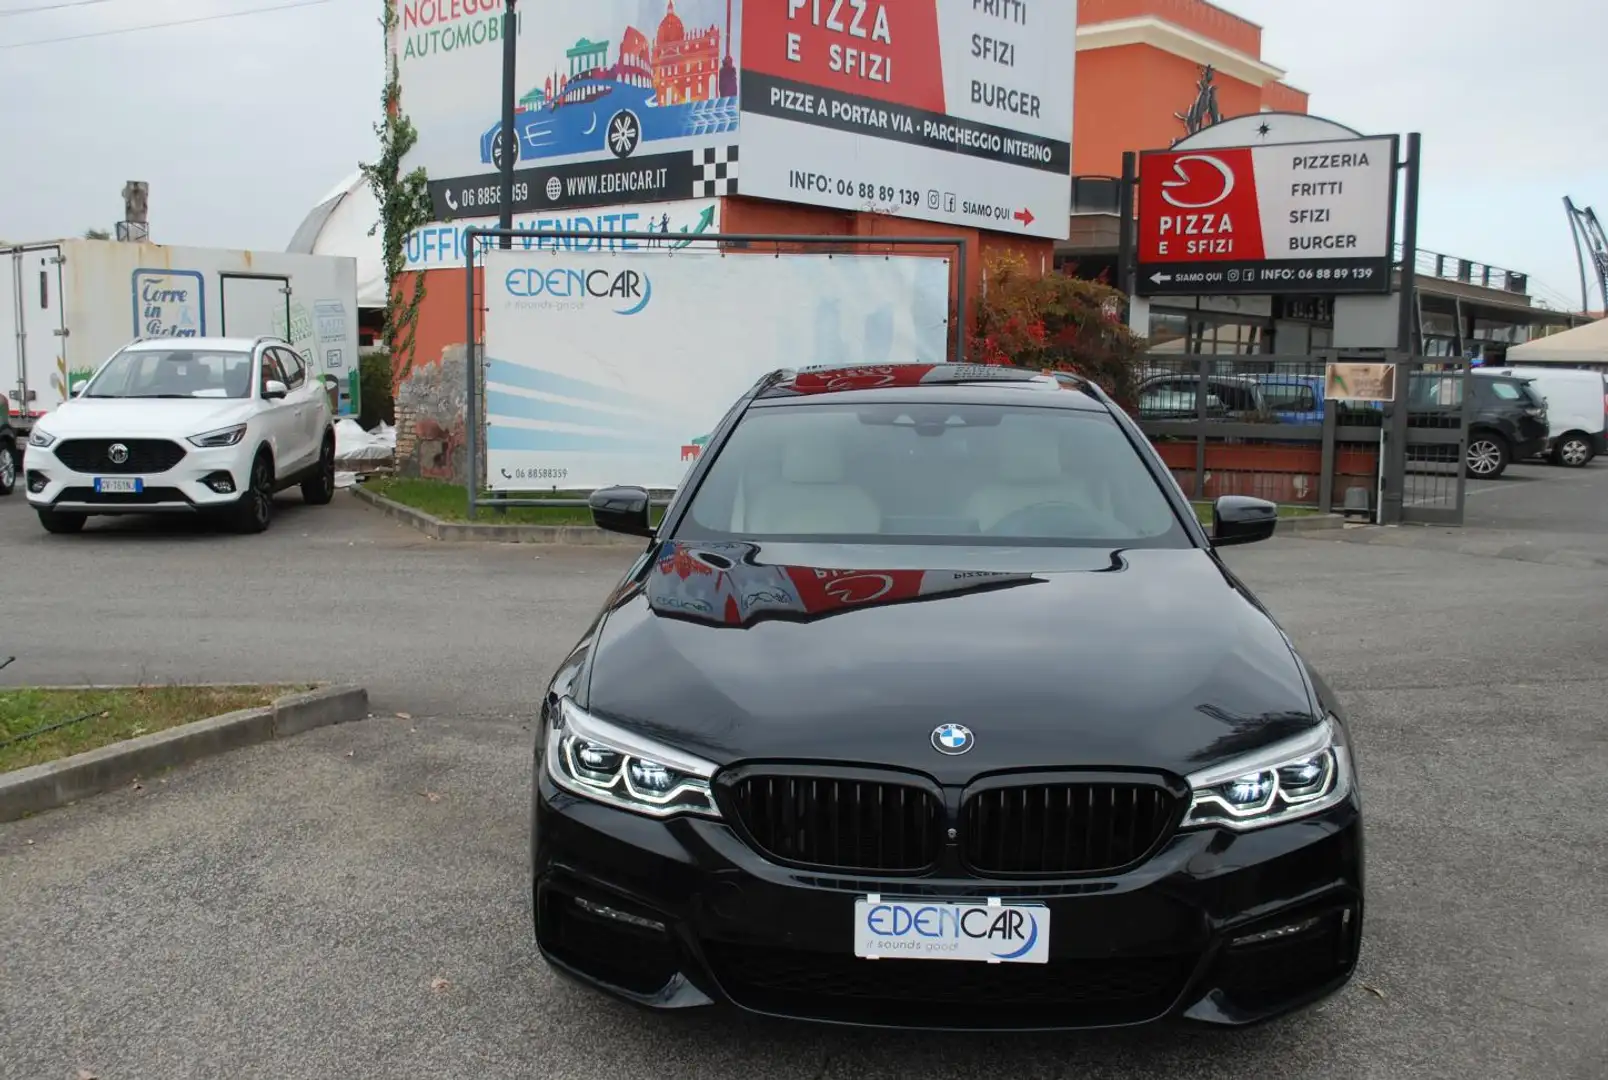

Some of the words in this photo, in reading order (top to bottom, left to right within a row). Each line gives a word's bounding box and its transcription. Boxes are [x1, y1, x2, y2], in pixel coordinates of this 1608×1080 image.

[404, 10, 522, 61] AUTOMOBII
[787, 31, 801, 62] E
[829, 43, 891, 83] SFIZI
[971, 33, 1014, 67] SFIZI
[971, 79, 1040, 119] BURGER
[770, 87, 814, 115] PIZZE
[817, 98, 829, 118] A
[831, 101, 888, 129] PORTAR
[890, 111, 914, 135] VIA
[923, 119, 1001, 152] PARCHEGGIO
[1003, 138, 1052, 163] INTERNO
[1292, 153, 1369, 170] PIZZERIA
[462, 188, 474, 207] 06
[567, 168, 668, 196] WWW.EDENCAR.IT
[789, 169, 832, 194] INFO:
[836, 178, 854, 197] 06
[858, 183, 875, 200] 88
[879, 186, 895, 203] 89
[899, 189, 920, 207] 139
[962, 201, 992, 217] SIAMO
[994, 206, 1010, 221] QUI
[1291, 181, 1343, 196] FRITTI
[1159, 213, 1233, 235] PIZZA
[1289, 208, 1330, 223] SFIZI
[518, 213, 640, 253] VENDITE
[1289, 234, 1357, 250] BURGER
[1159, 241, 1169, 255] E
[1187, 239, 1233, 254] SFIZI
[505, 268, 641, 298] EDENCAR
[1175, 273, 1204, 282] SIAMO
[1205, 272, 1222, 282] QUI
[1260, 269, 1296, 280] INFO:
[1298, 269, 1313, 279] 06
[1316, 268, 1331, 279] 88
[1333, 268, 1348, 279] 89
[1352, 267, 1373, 279] 139
[143, 278, 188, 303] Torre
[515, 468, 525, 478] 06
[867, 905, 1025, 940] EDENCAR
[877, 940, 921, 951] sounds
